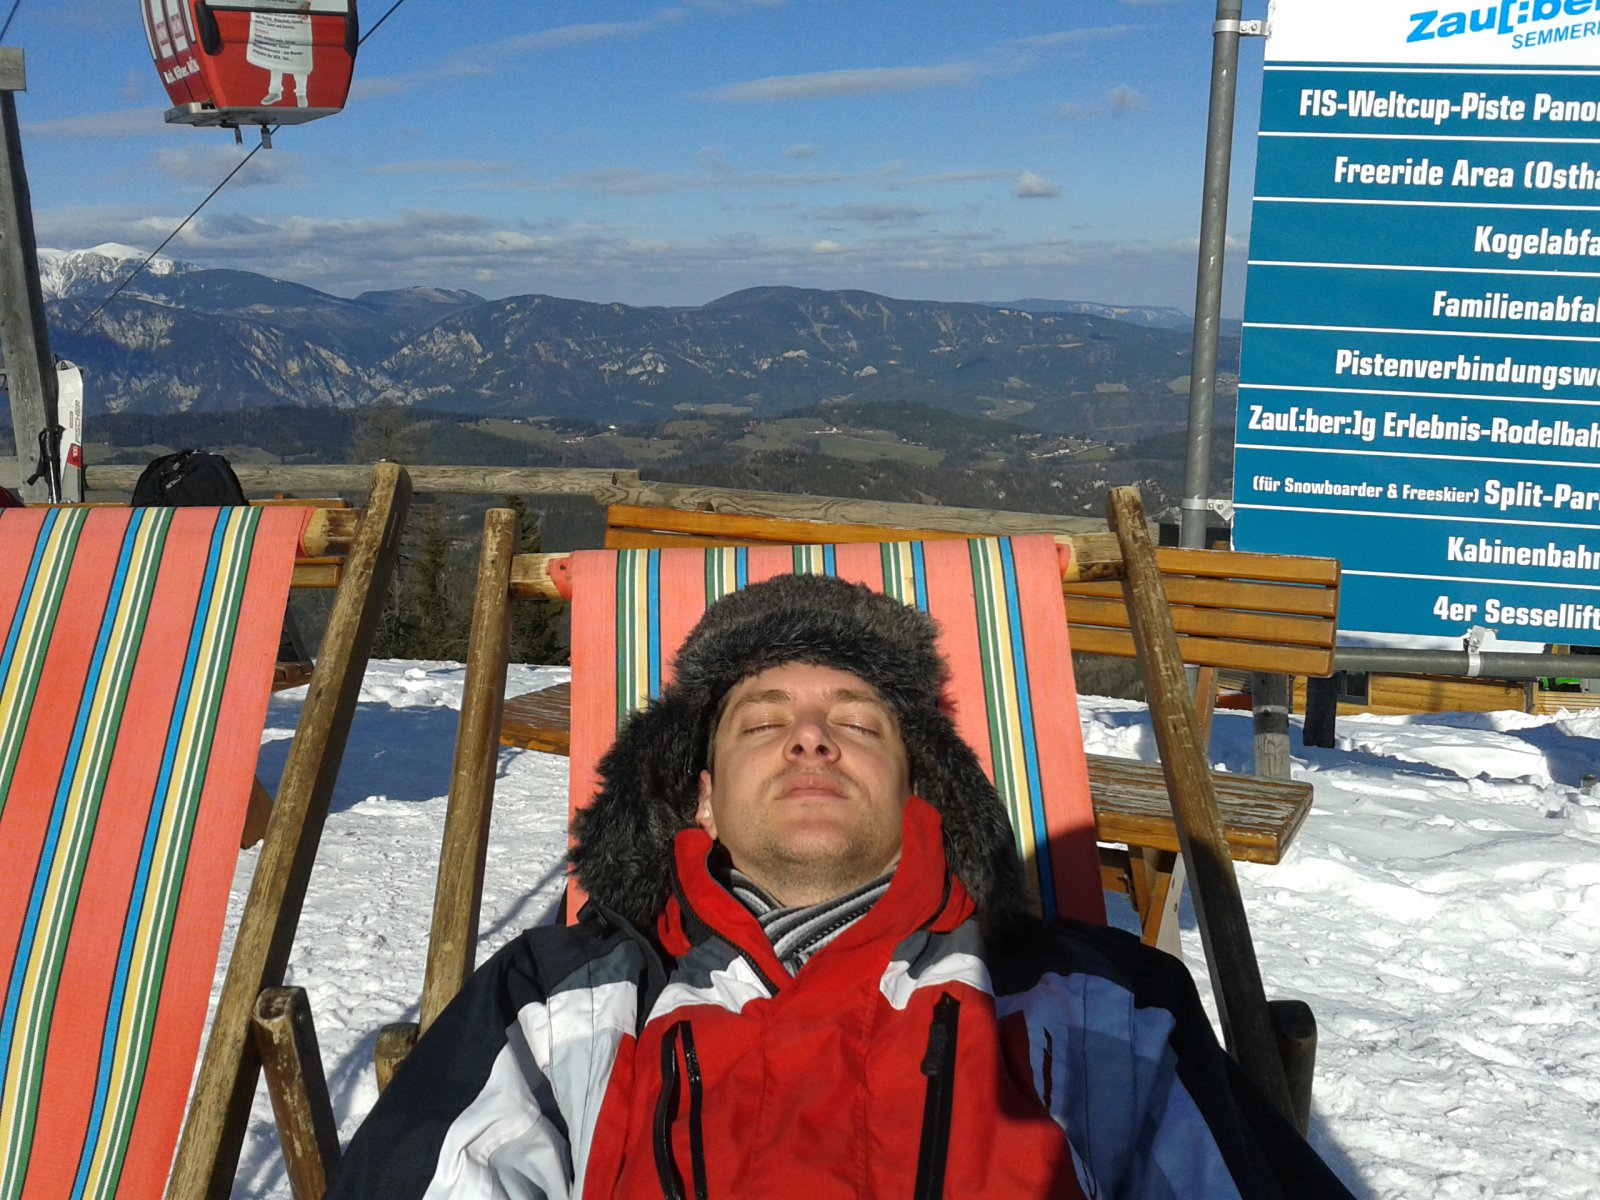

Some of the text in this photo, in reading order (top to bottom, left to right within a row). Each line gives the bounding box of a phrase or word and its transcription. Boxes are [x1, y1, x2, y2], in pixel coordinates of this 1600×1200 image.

[1299, 89, 1525, 125] FIS-Weltcup-Piste
[1334, 156, 1443, 186] Freeride
[1452, 160, 1513, 188] Area
[1433, 291, 1600, 323] Familienabfa
[1252, 476, 1600, 511] (für Snowboarder & Freeskier) Split-Par
[1433, 595, 1600, 630] 4er Sessellift
